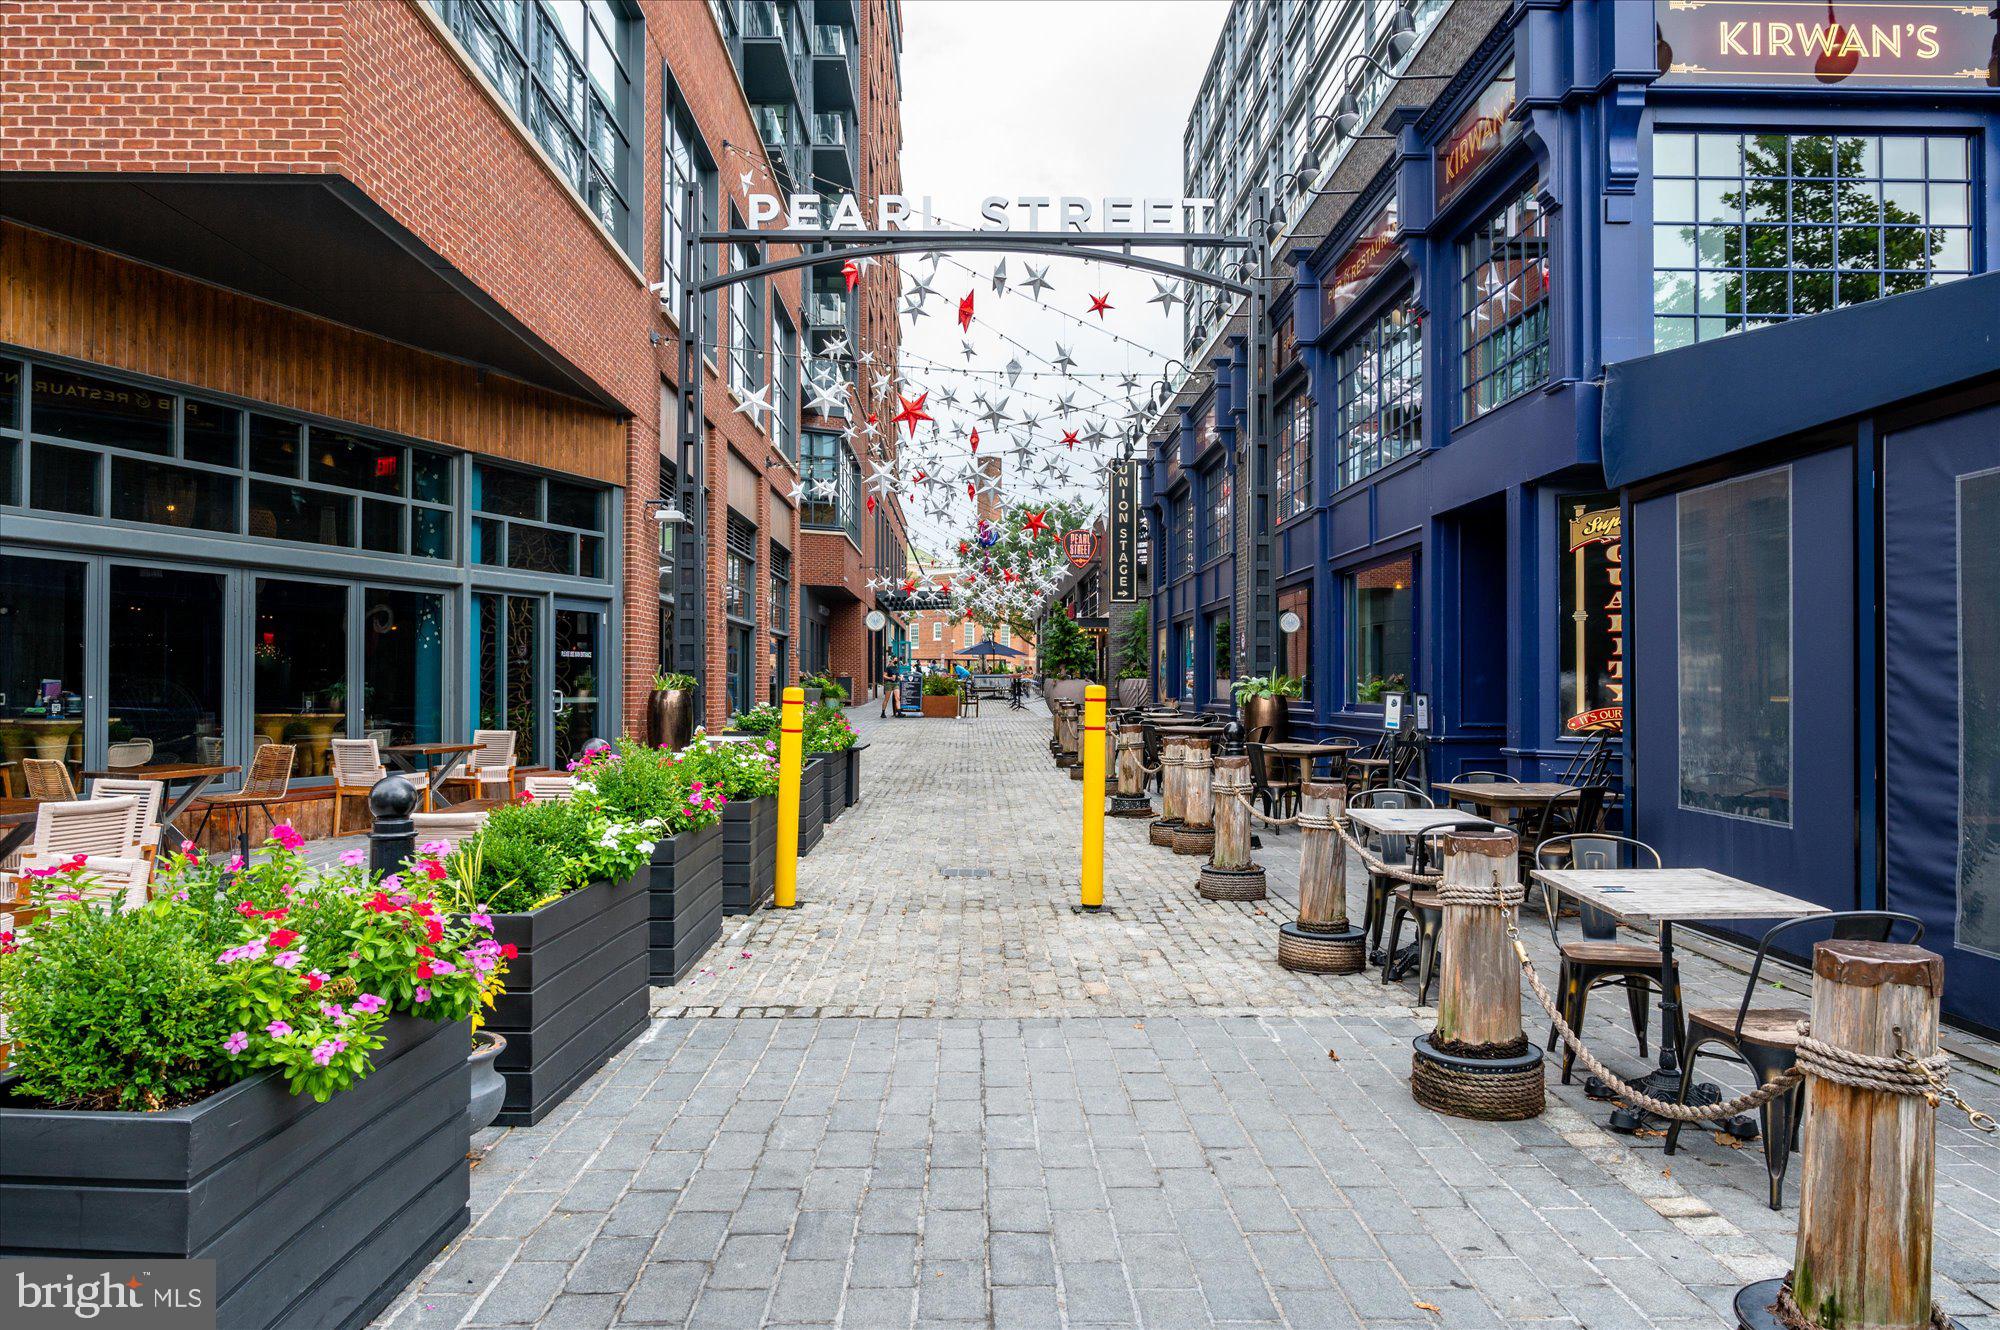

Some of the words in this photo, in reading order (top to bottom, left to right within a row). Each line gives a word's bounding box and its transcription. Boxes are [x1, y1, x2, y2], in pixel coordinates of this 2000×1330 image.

[1719, 22, 1940, 59] KIRWAN'S
[748, 193, 950, 231] PEARL
[979, 196, 1216, 232] STREET
[1118, 464, 1128, 523] UNION
[1070, 533, 1090, 545] PEARL
[1584, 516, 1621, 535] Sup
[1070, 544, 1091, 555] STREET
[1118, 528, 1128, 587] STAGE
[1579, 712, 1598, 725] IT'S
[1599, 710, 1622, 720] OUR
